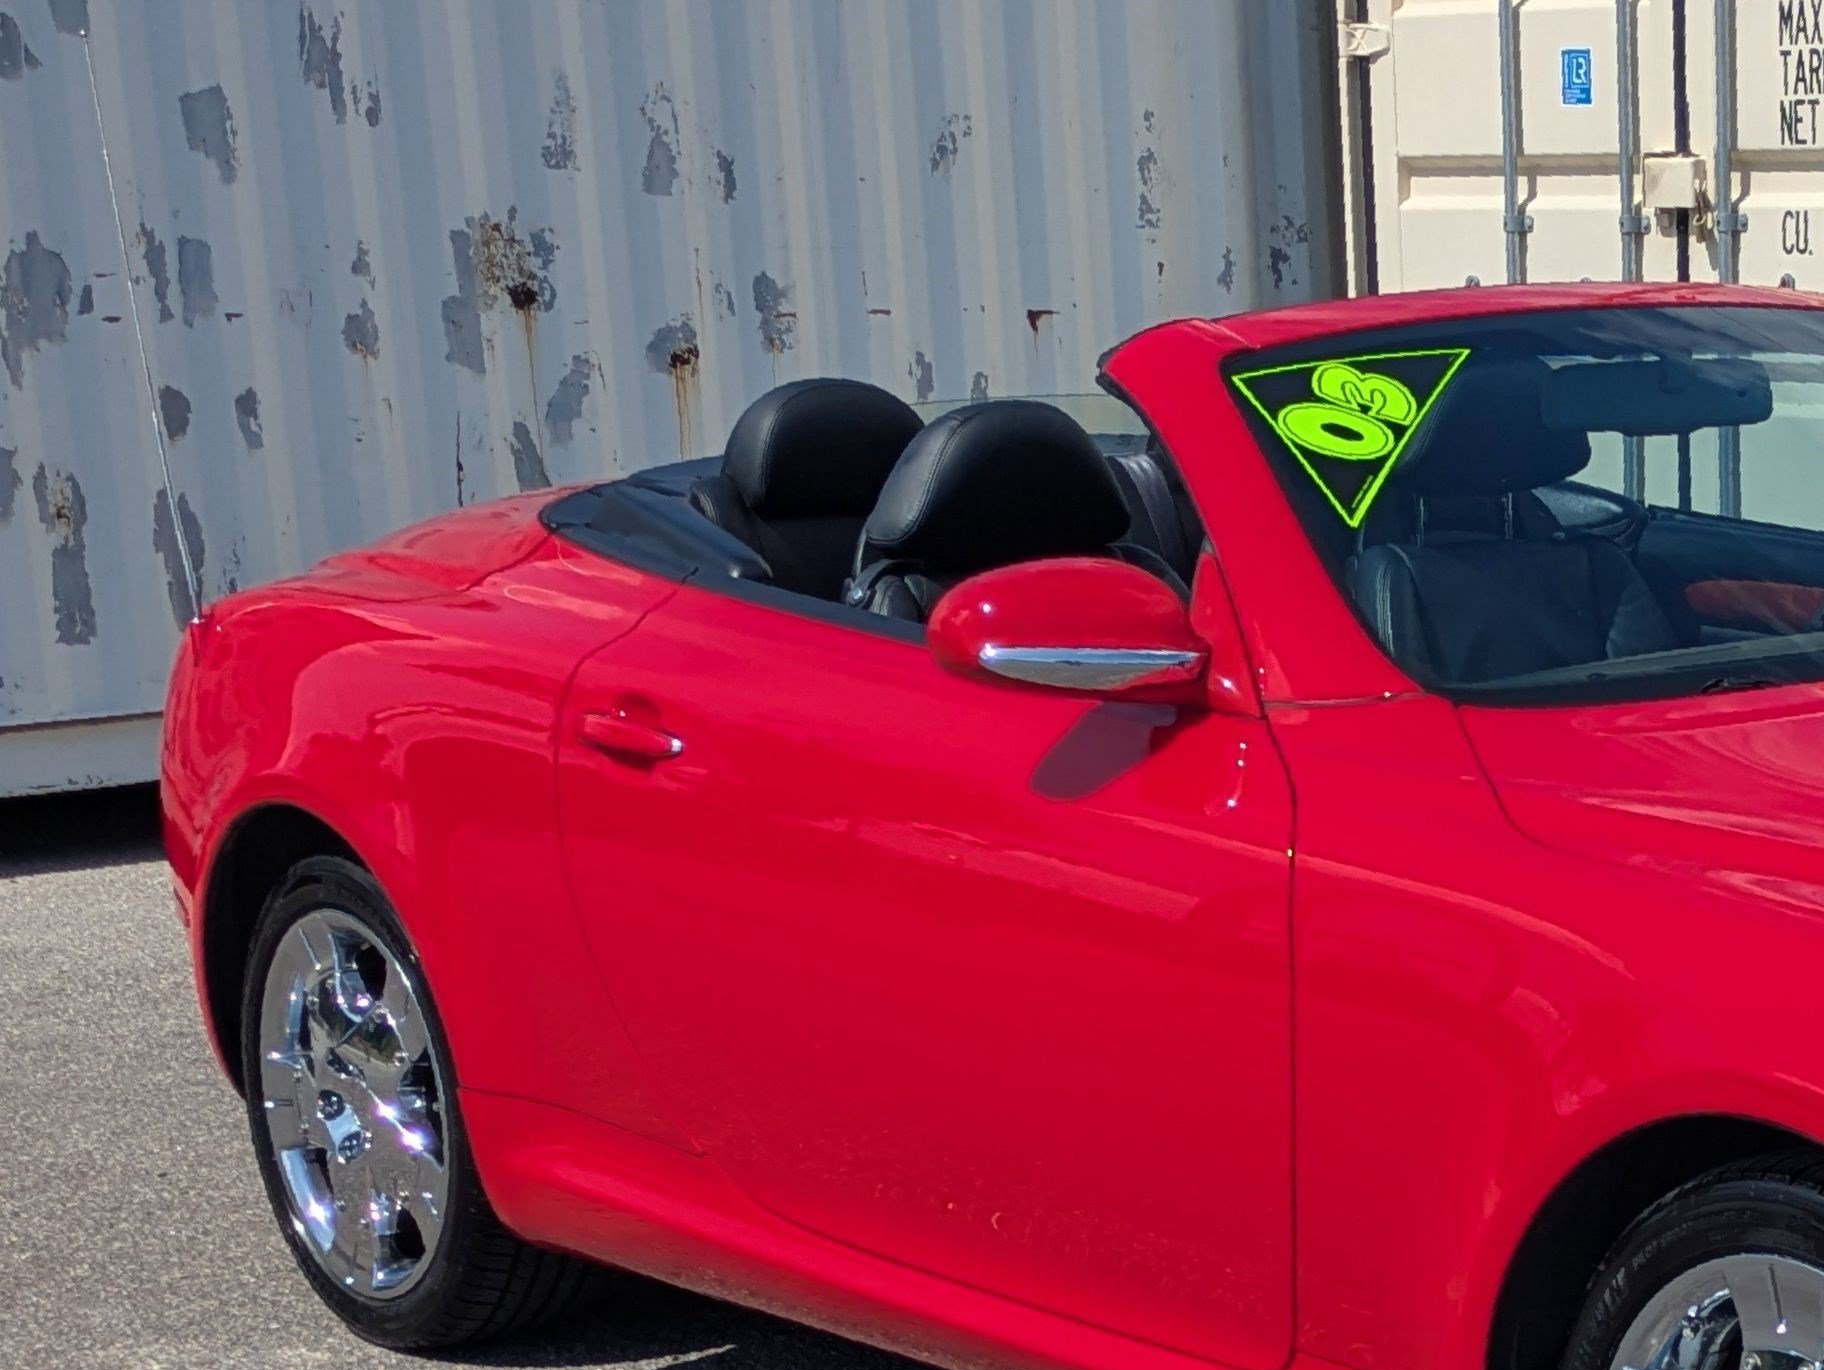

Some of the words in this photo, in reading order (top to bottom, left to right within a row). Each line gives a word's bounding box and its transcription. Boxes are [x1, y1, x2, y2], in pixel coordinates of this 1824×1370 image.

[1779, 98, 1821, 145] NET
[1781, 209, 1814, 256] CU.
[1277, 361, 1418, 460] 03
